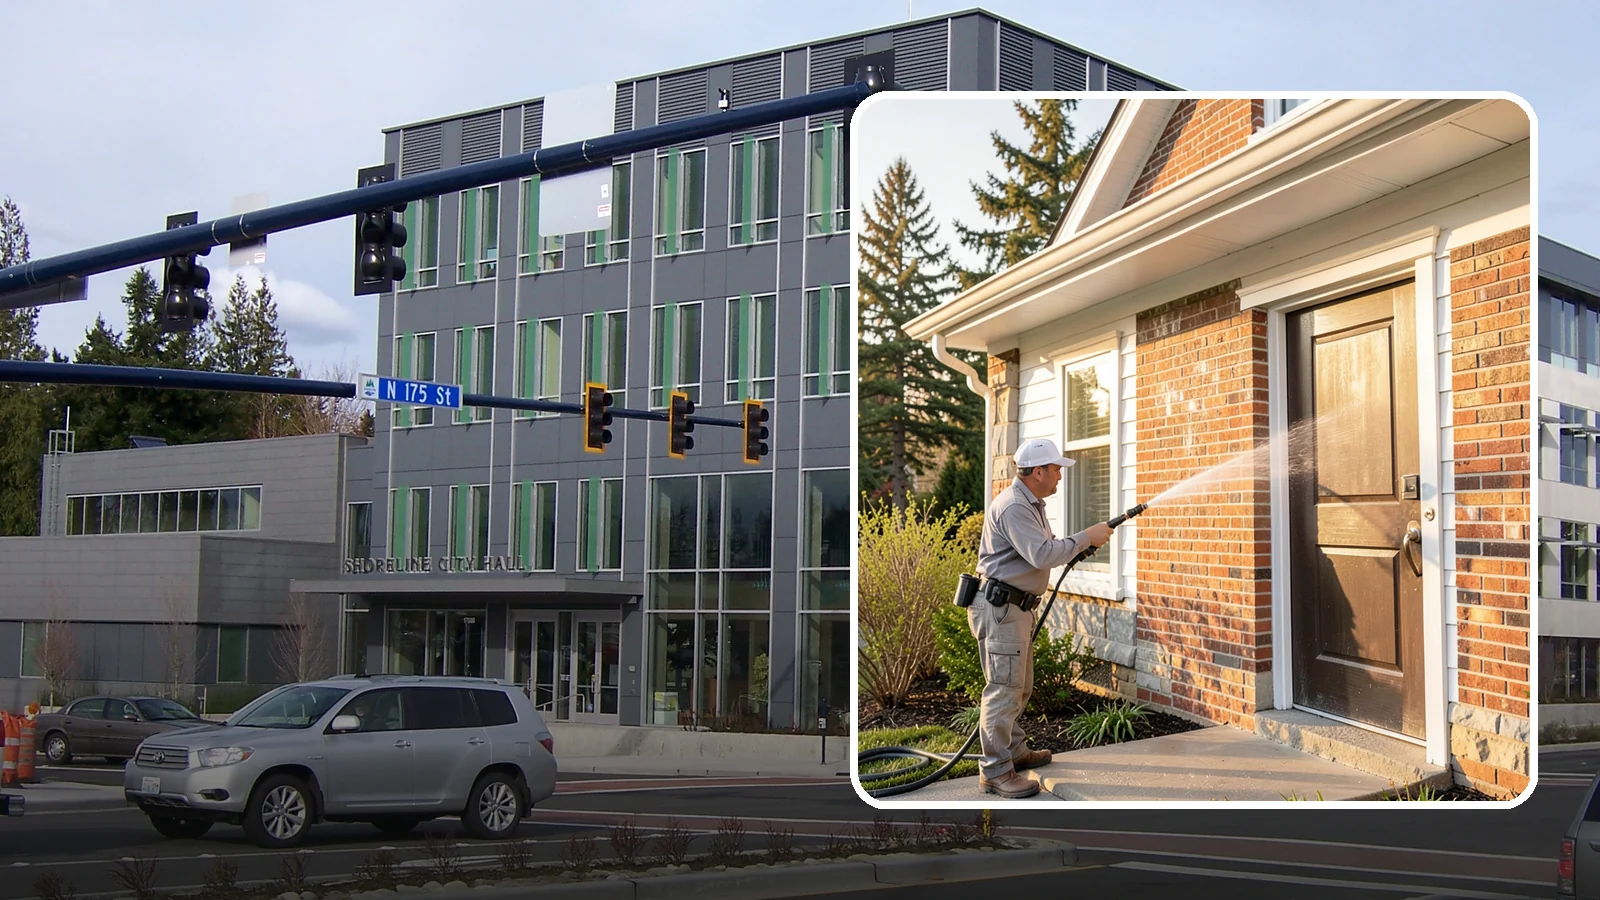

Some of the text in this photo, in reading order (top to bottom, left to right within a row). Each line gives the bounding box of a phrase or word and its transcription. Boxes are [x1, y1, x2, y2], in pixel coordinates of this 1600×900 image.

[387, 380, 451, 406] N 175 St
[344, 555, 526, 574] SHORELINE CITY HALL
